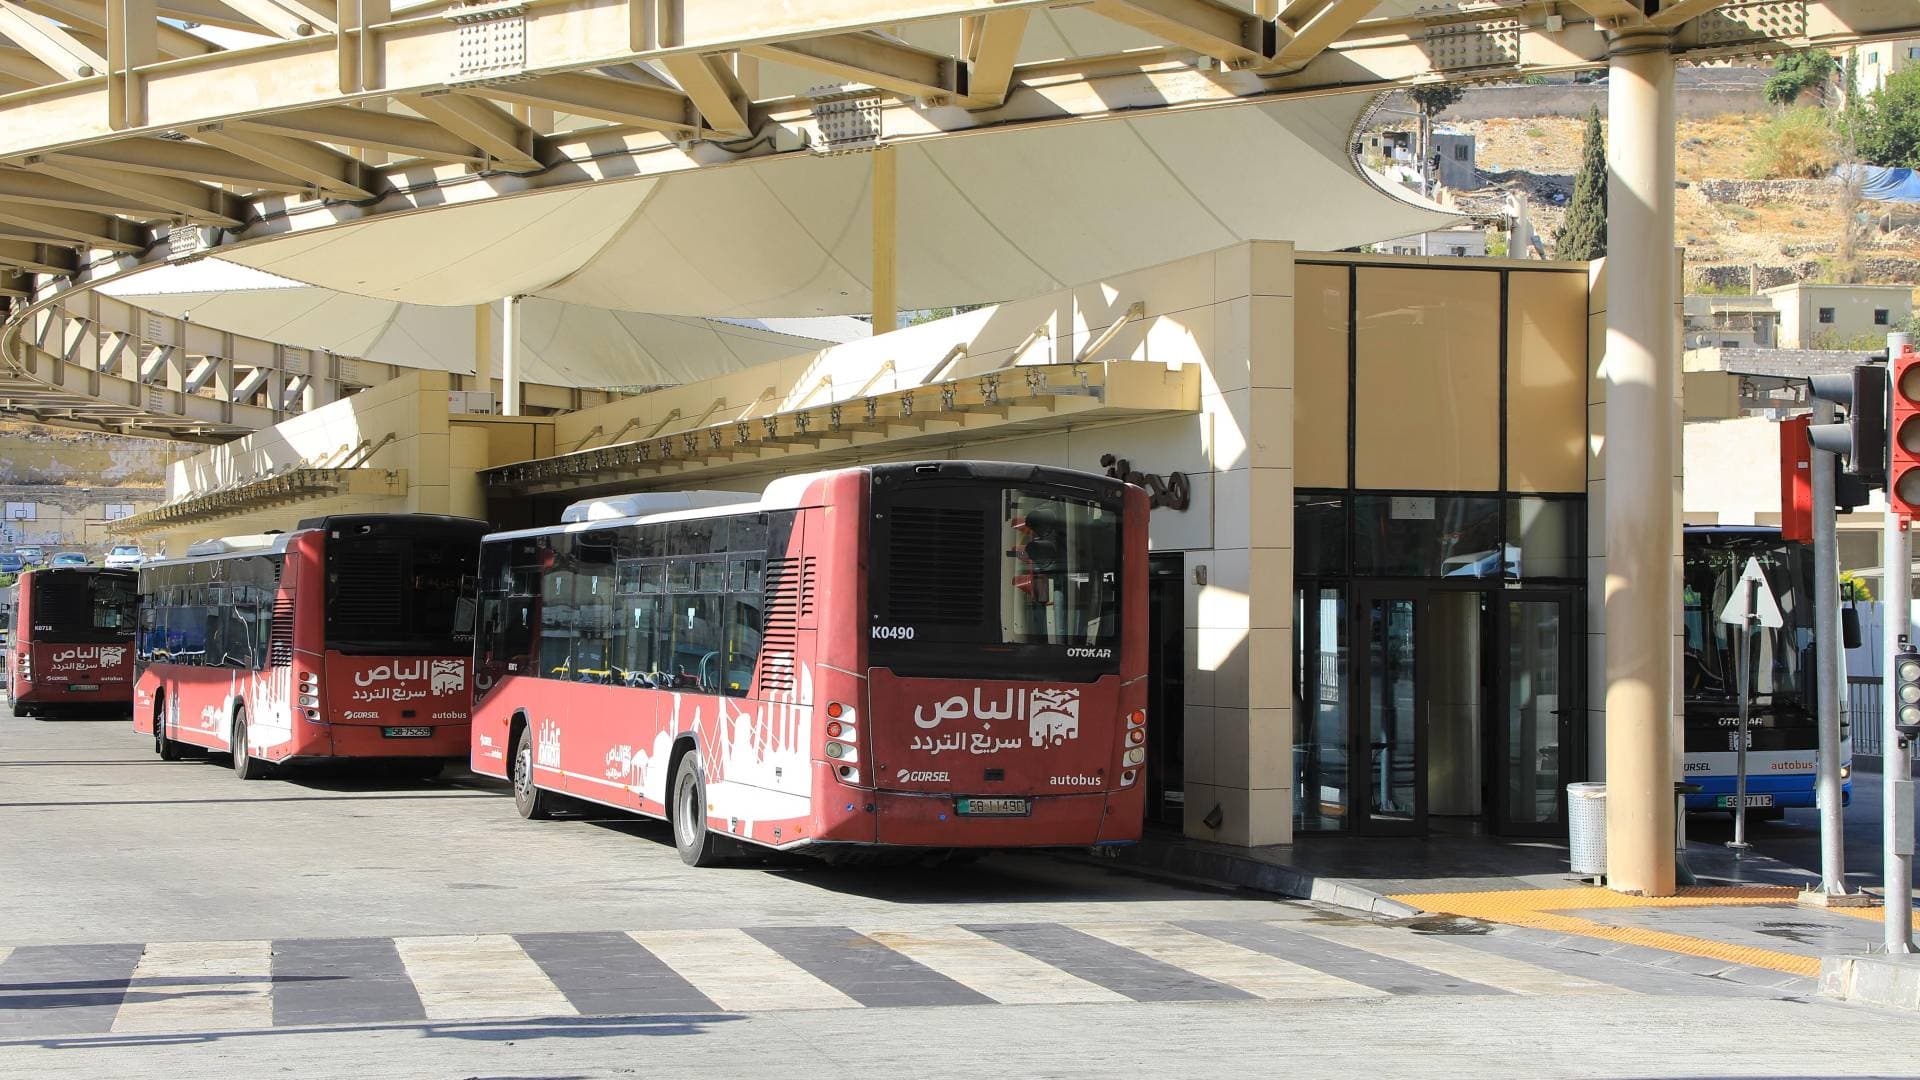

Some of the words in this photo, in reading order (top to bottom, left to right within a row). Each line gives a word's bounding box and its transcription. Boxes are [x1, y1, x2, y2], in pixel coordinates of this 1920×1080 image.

[872, 626, 914, 640] K0490
[52, 646, 99, 663] الباص
[1067, 647, 1112, 658] OTOKAR
[354, 660, 428, 687] الباص
[352, 687, 389, 702] التردد
[391, 688, 427, 702] سريع
[432, 710, 467, 719] autobus
[914, 687, 1025, 730] الباص
[1718, 717, 1764, 726] OTOAR
[910, 732, 966, 755] التردد
[970, 733, 1022, 754] سريع
[1771, 760, 1813, 770] autobus
[1050, 774, 1101, 786] autobus
